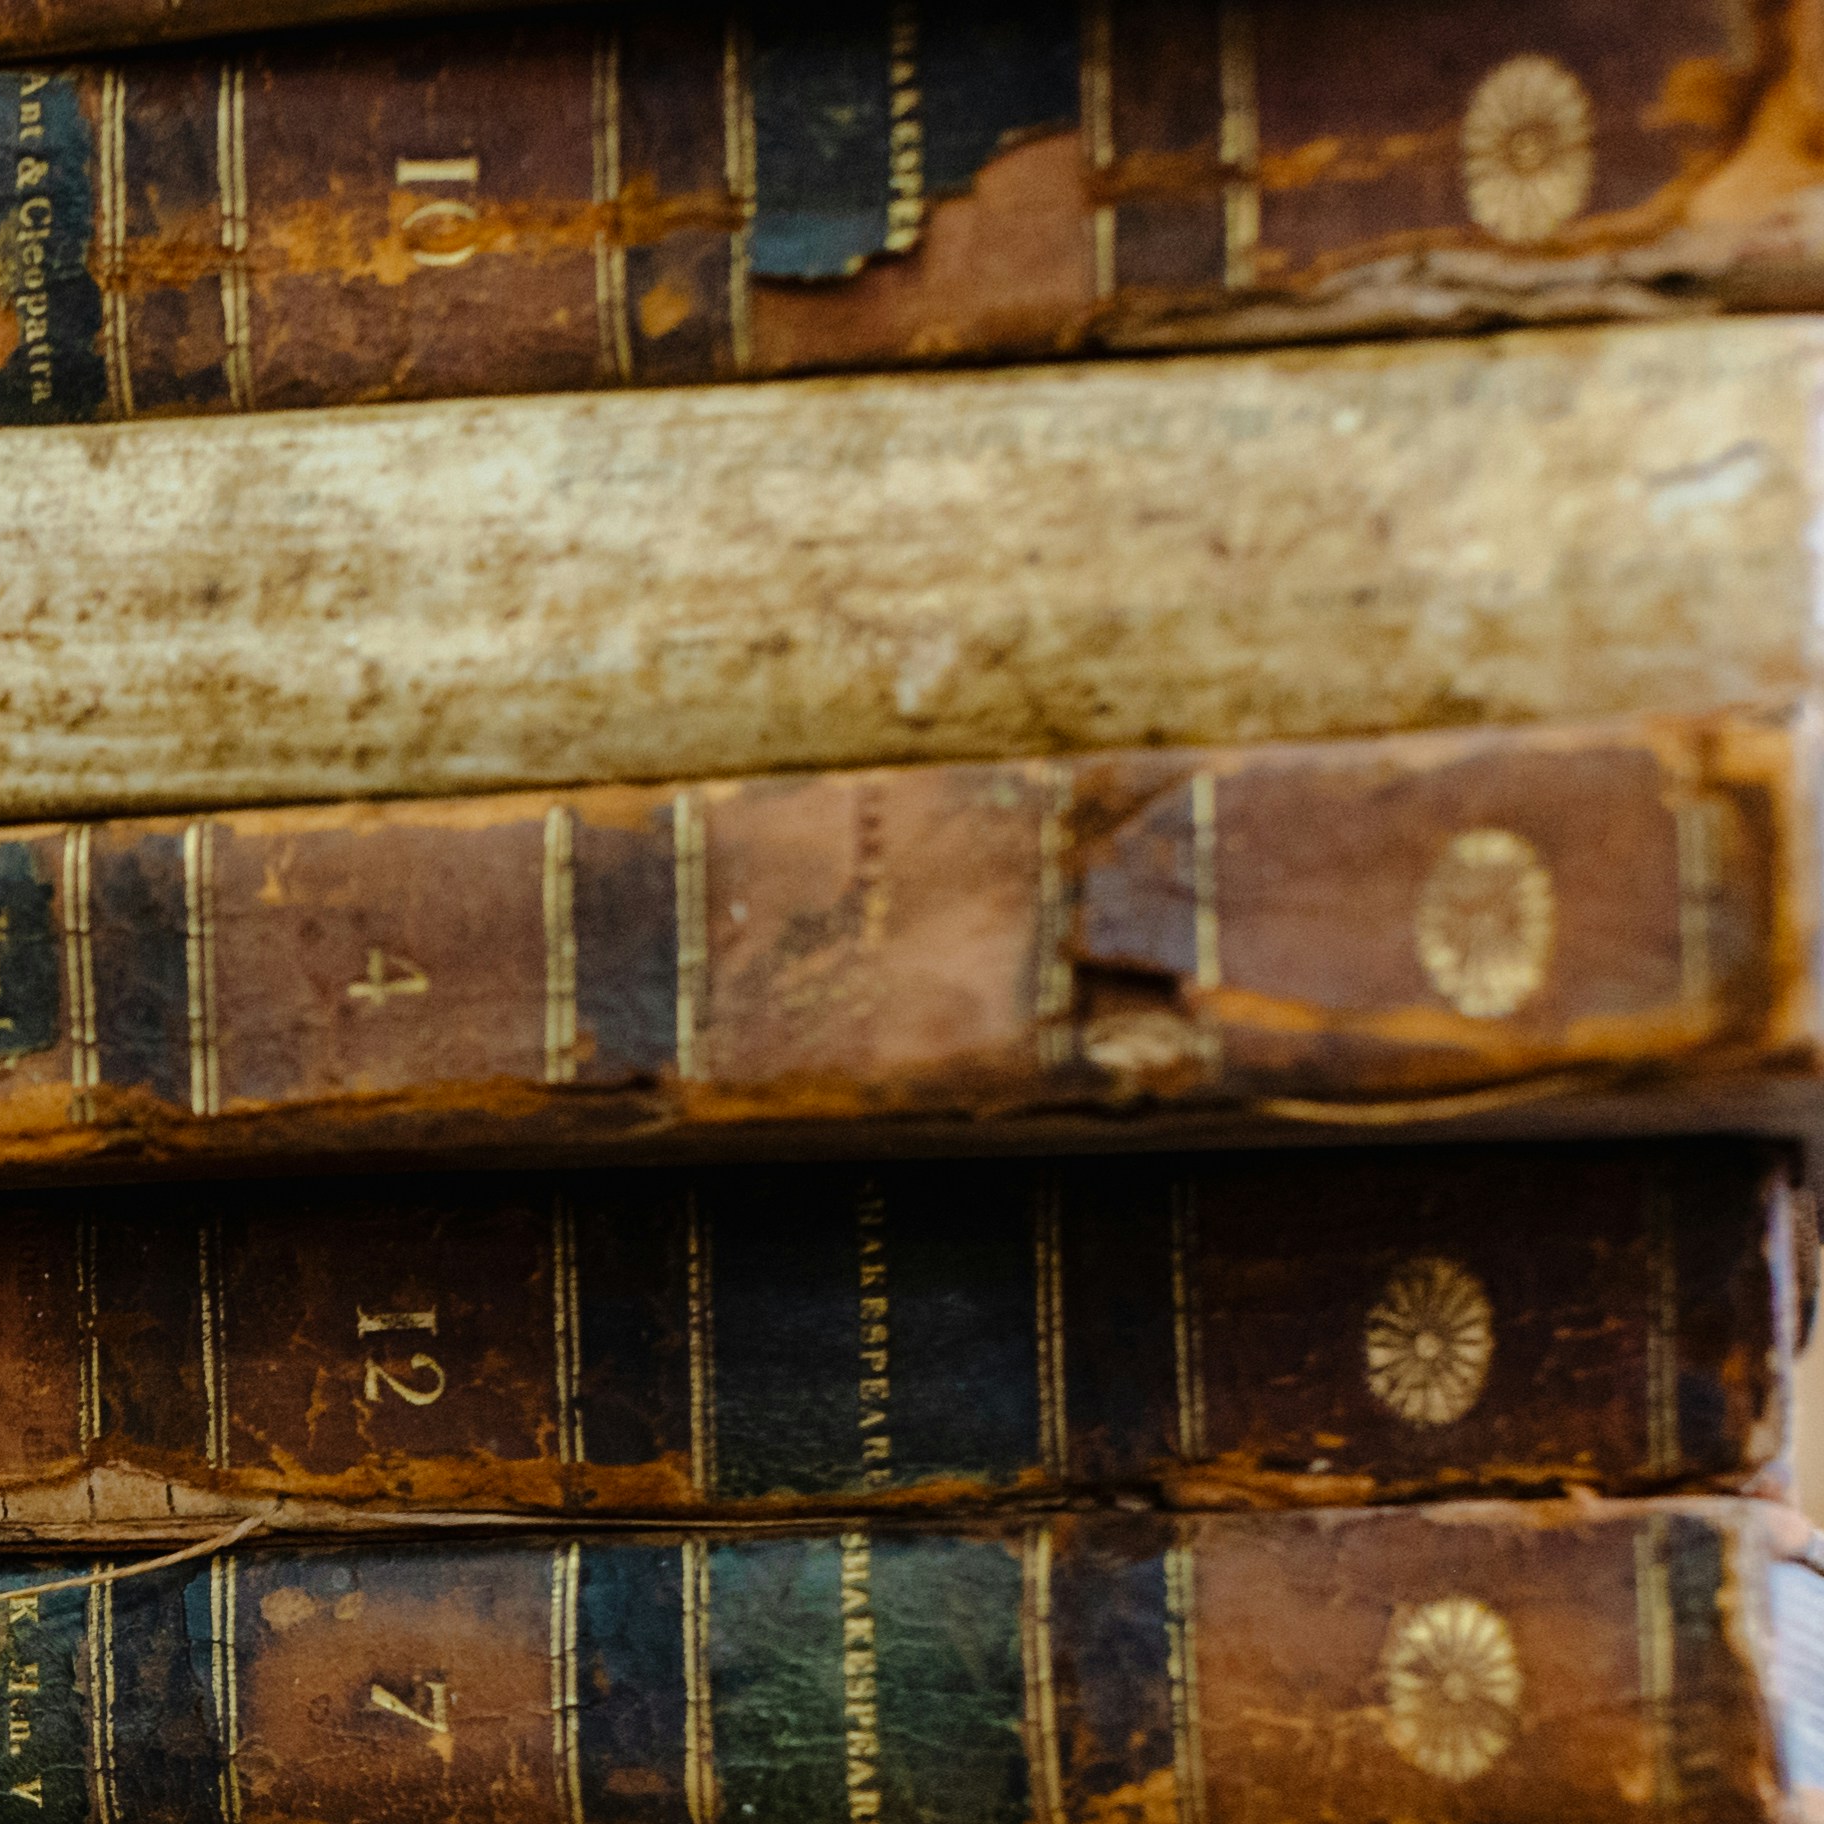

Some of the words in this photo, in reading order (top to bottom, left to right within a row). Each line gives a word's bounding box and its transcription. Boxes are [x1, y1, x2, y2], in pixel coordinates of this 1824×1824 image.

[18, 73, 50, 141] Ant
[15, 157, 50, 190] &
[397, 156, 479, 268] 10
[15, 196, 53, 405] Cleopatra
[346, 947, 430, 1018] 4
[356, 1305, 447, 1407] 12
[7, 1660, 41, 1757] Hn.
[369, 1680, 449, 1734] 7
